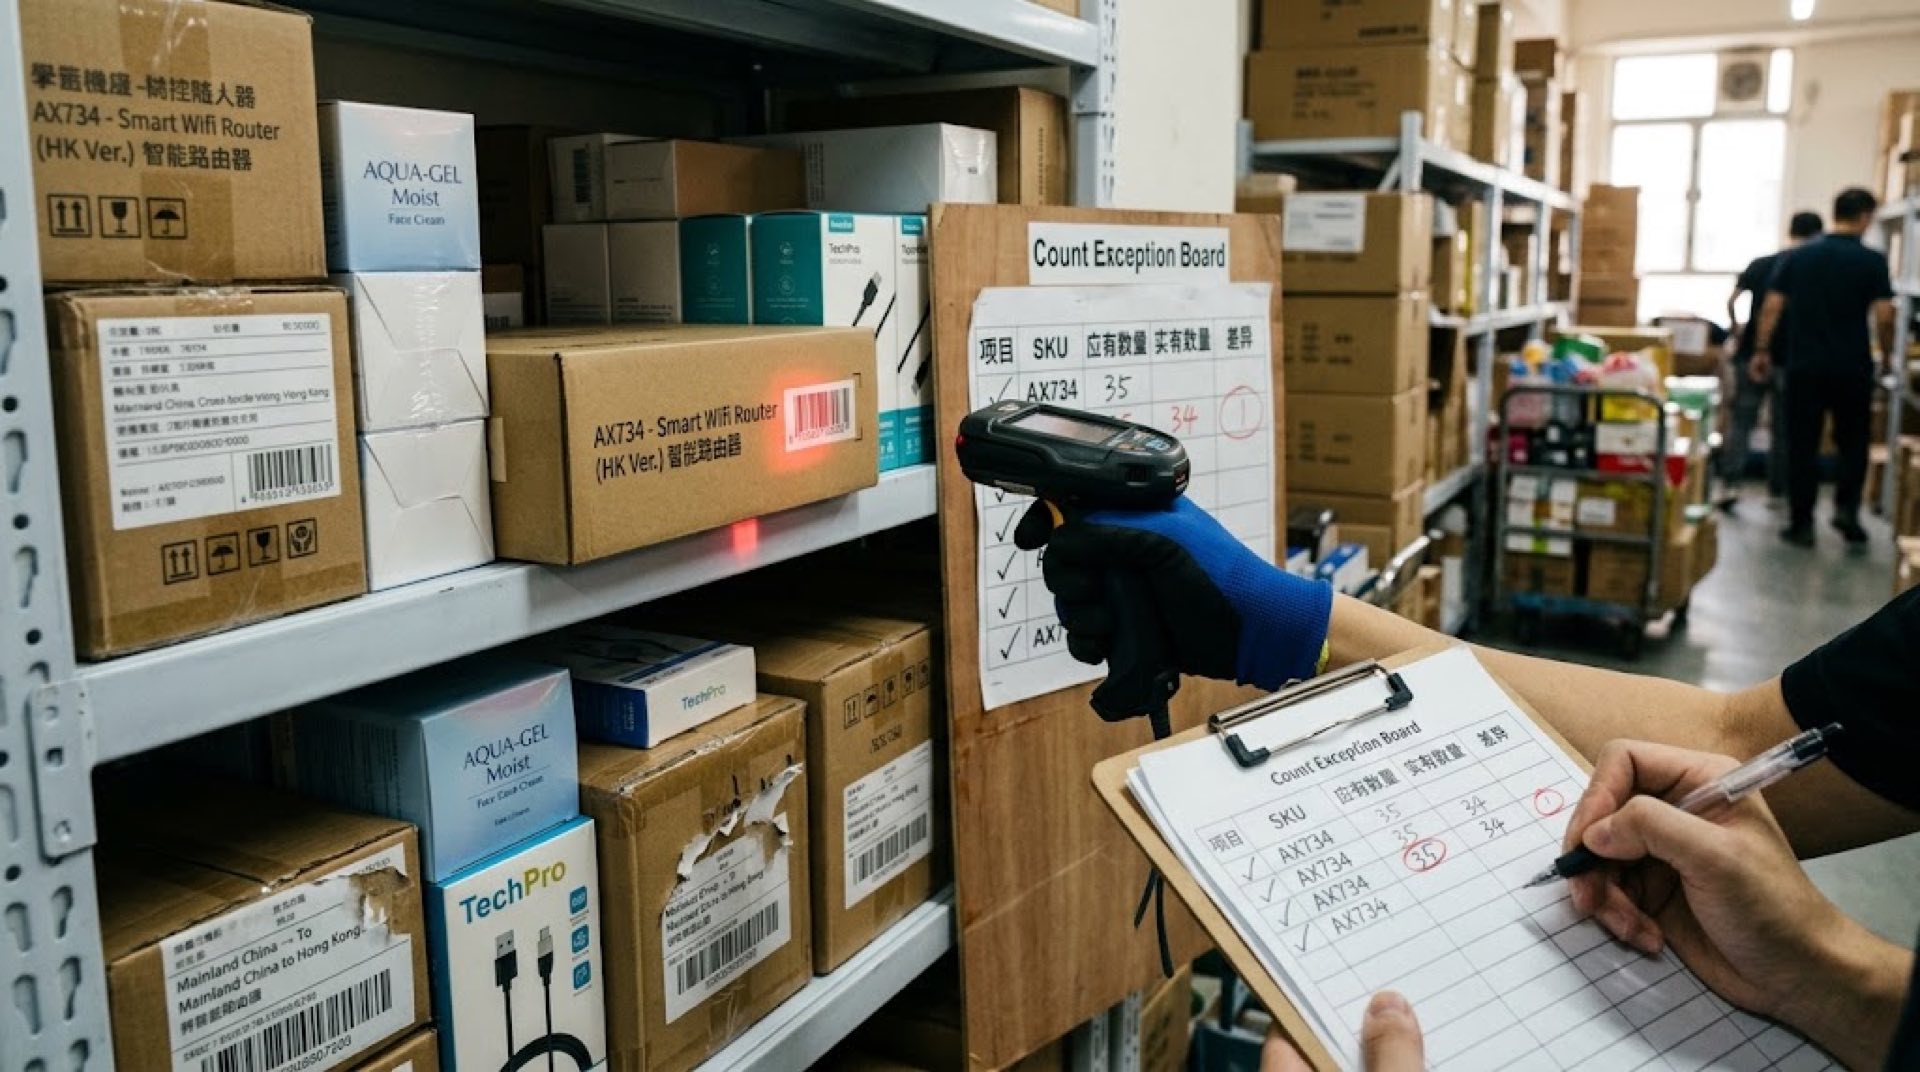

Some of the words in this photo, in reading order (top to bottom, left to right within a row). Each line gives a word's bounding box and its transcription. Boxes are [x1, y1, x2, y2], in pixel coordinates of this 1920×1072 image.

[33, 101, 100, 126] AX734
[118, 108, 177, 134] Smart
[182, 113, 216, 136] Wifi
[222, 116, 280, 141] Router
[36, 135, 78, 163] (HK
[83, 140, 135, 168] Ver.)
[142, 141, 253, 171] 智能路由器
[363, 160, 463, 184] AQUA-GEL
[391, 188, 440, 207] Moist
[388, 213, 411, 225] Face
[1034, 237, 1089, 267] Count
[1094, 240, 1176, 274] Exception
[1181, 241, 1226, 268] Board
[980, 337, 1014, 365] 项目
[1033, 336, 1068, 360] SKU
[1087, 330, 1148, 359] 应有数量
[1154, 327, 1211, 355] 实有数量
[1027, 379, 1078, 402] AX734
[1104, 374, 1132, 402] 35
[594, 419, 644, 448] AX734
[657, 412, 702, 438] Smart
[705, 406, 730, 429] Wifi
[734, 403, 778, 423] Router
[1171, 404, 1198, 433] 34
[596, 454, 625, 485] (HK
[630, 448, 663, 474] Ver.)
[682, 683, 726, 710] TechPro
[463, 723, 550, 770] AQUA-GEL
[1313, 736, 1382, 770] Exception
[1380, 720, 1422, 745] Board
[487, 755, 531, 784] Moist
[1268, 805, 1307, 829] SKU
[1374, 801, 1401, 823] 35
[1392, 822, 1418, 849] 35
[1461, 795, 1487, 816] 34
[1278, 829, 1334, 864] AX734
[1411, 842, 1437, 869] 35
[1479, 818, 1508, 839] 34
[1297, 852, 1352, 887] AX734
[459, 861, 567, 924] TechPro
[1313, 874, 1370, 911] AX734
[1331, 897, 1390, 934] AX734
[177, 956, 239, 993] Mainland
[242, 942, 278, 965] China
[296, 928, 312, 940] To
[179, 979, 240, 1015] Mainland
[243, 962, 279, 985] China
[282, 955, 295, 968] to
[298, 939, 329, 962] Hong
